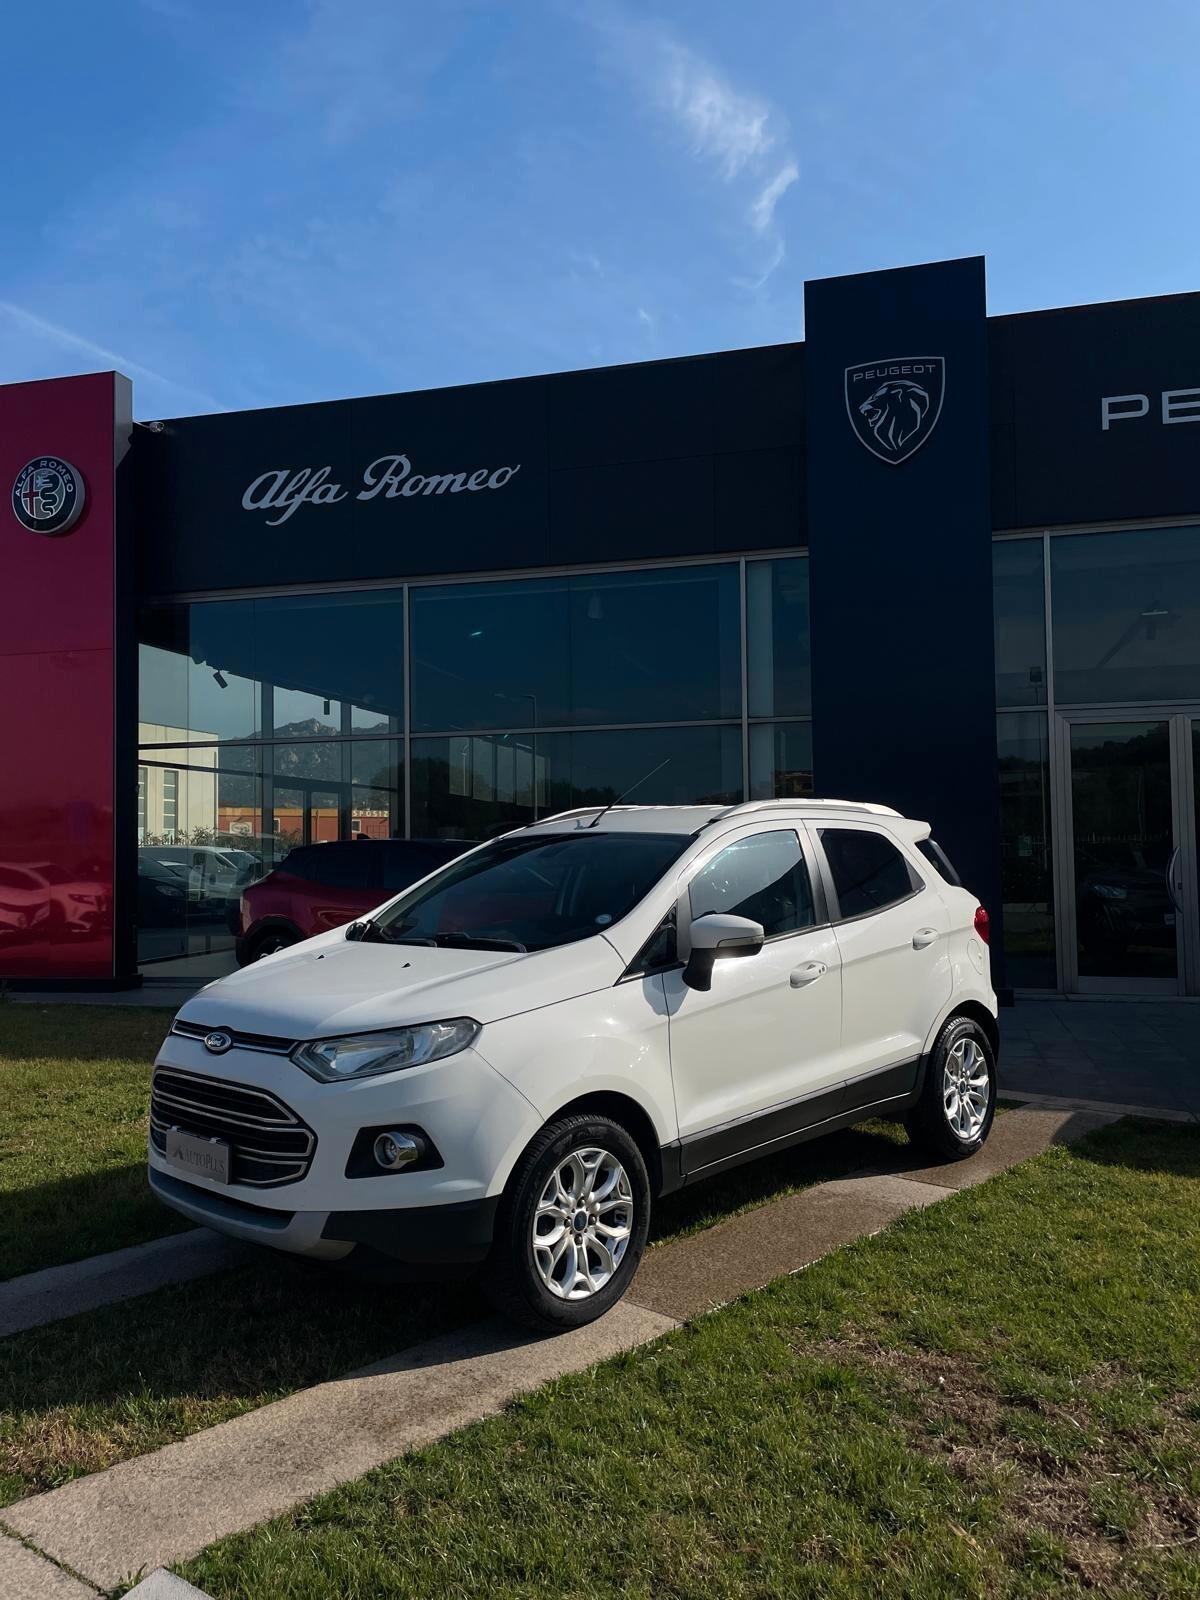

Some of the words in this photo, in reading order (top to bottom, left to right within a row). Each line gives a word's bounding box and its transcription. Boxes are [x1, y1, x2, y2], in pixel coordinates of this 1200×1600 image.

[853, 364, 936, 383] PEUGEOT
[15, 465, 35, 497] ALFA
[40, 460, 74, 493] ROMEO
[242, 465, 349, 526] Alfa
[356, 453, 521, 500] Romeo
